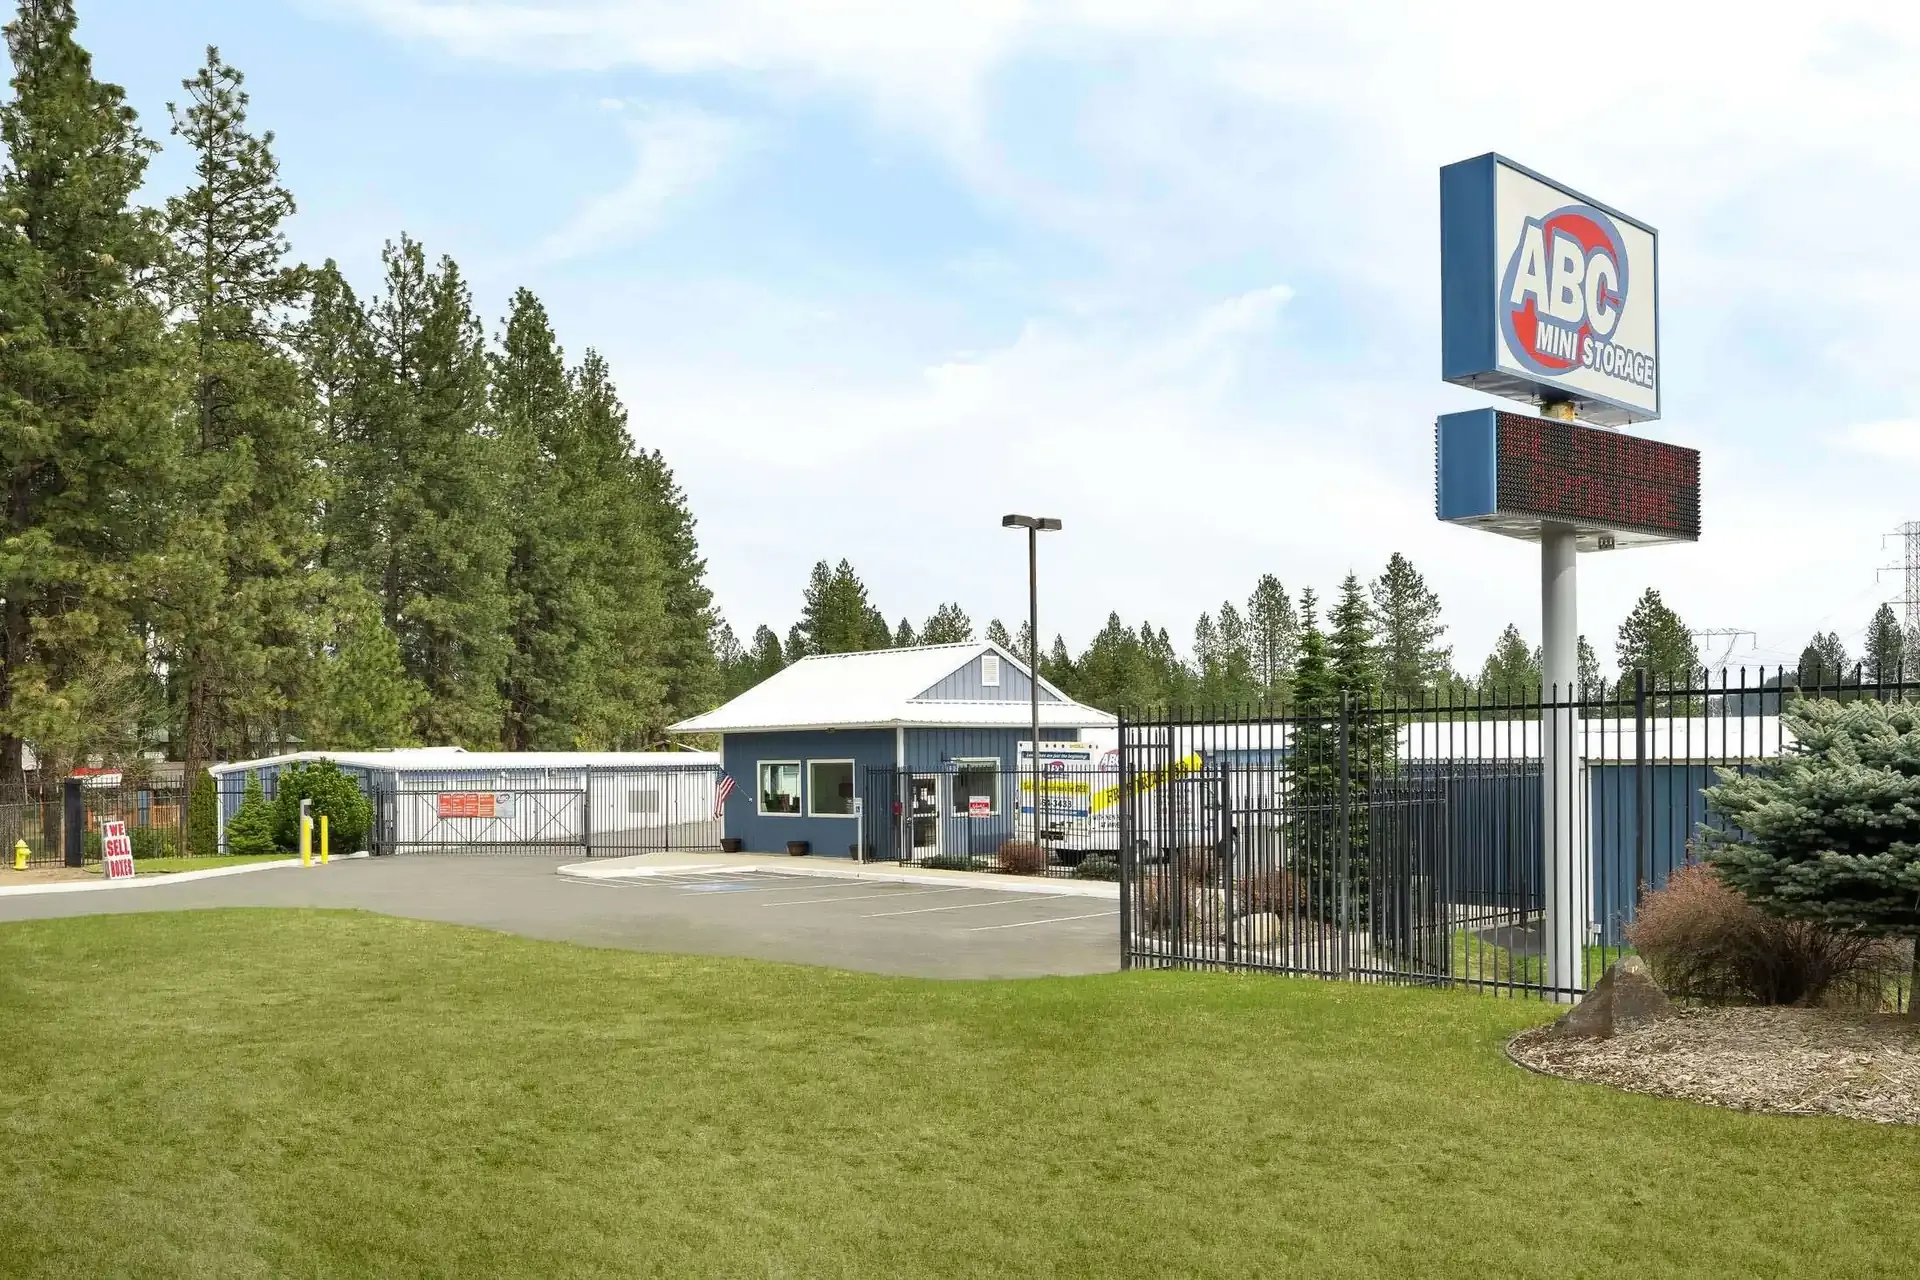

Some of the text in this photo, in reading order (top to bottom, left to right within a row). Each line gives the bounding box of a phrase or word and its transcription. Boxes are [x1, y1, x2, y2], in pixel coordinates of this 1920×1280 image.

[1510, 223, 1618, 336] ABC
[1536, 320, 1655, 387] MINI STORAGE
[109, 823, 124, 836] WE
[107, 839, 129, 856] SELL
[110, 859, 132, 877] BOXES
